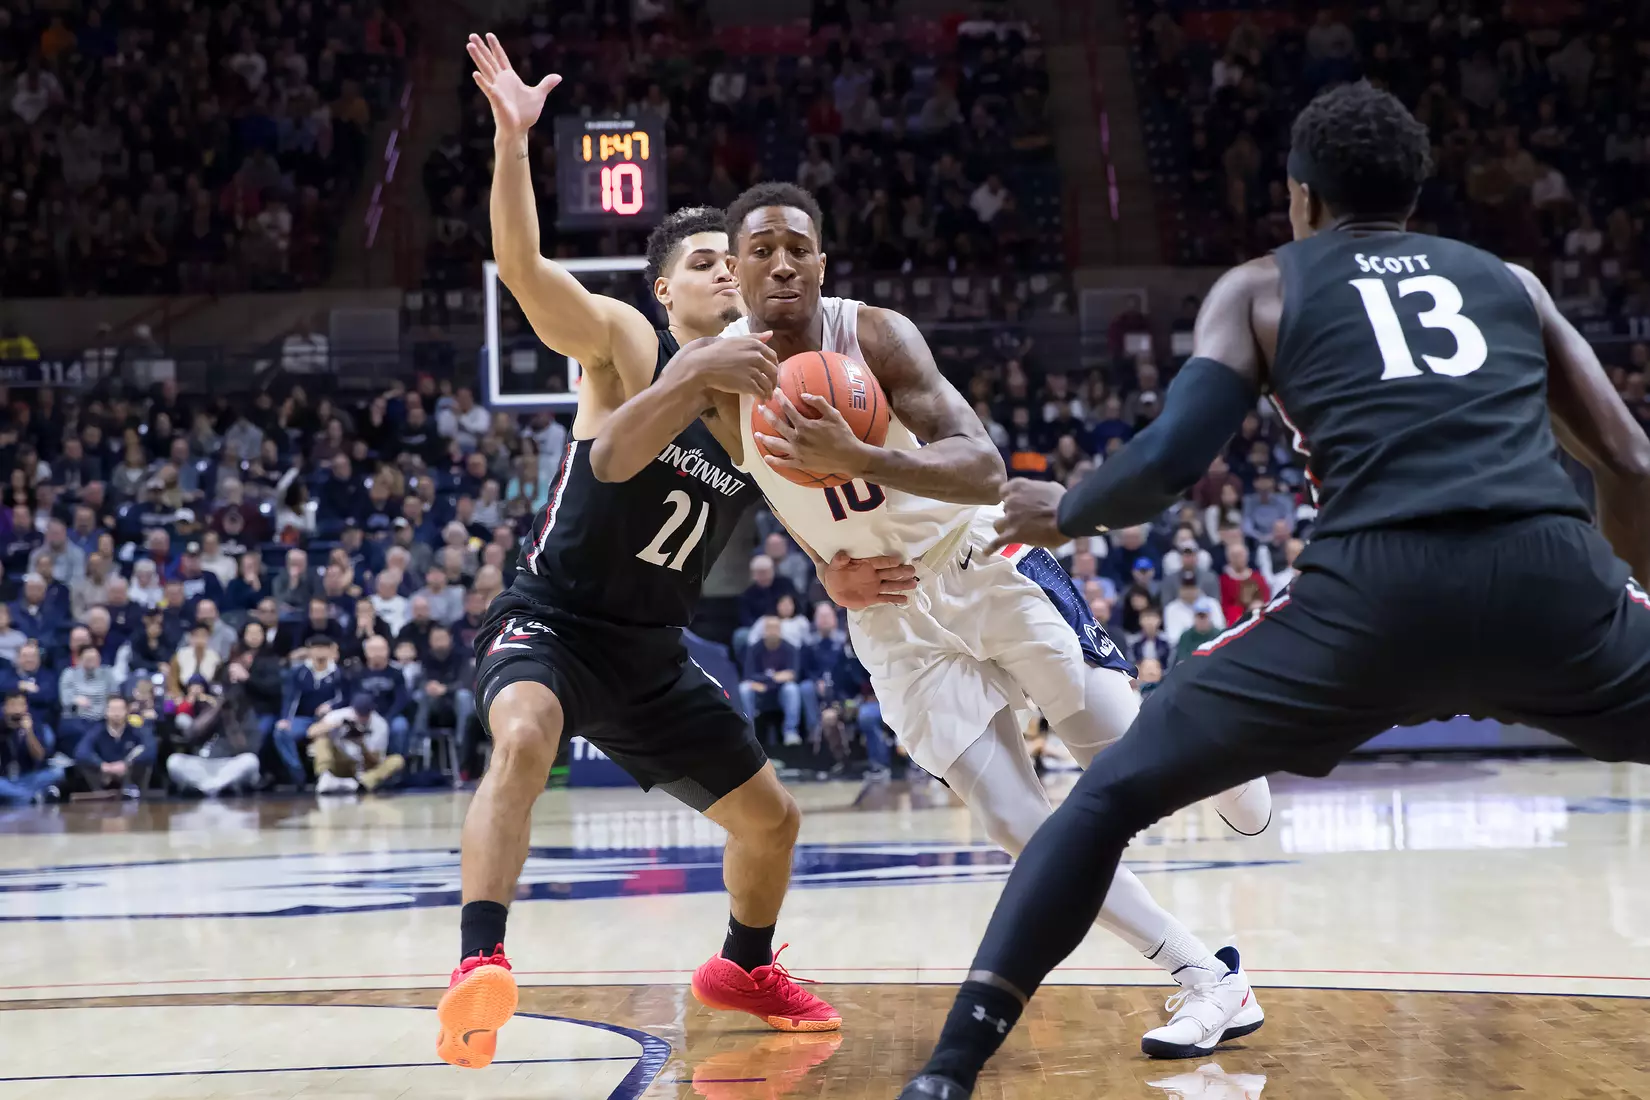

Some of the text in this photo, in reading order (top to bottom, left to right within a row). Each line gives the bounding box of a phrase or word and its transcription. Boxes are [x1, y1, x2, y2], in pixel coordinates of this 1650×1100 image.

[582, 131, 650, 162] 11:47
[601, 162, 644, 215] 10
[1354, 253, 1431, 274] SCOTT
[1348, 275, 1488, 380] 13
[40, 361, 83, 384] 114
[656, 443, 746, 497] INCINNATI
[635, 489, 710, 572] 21
